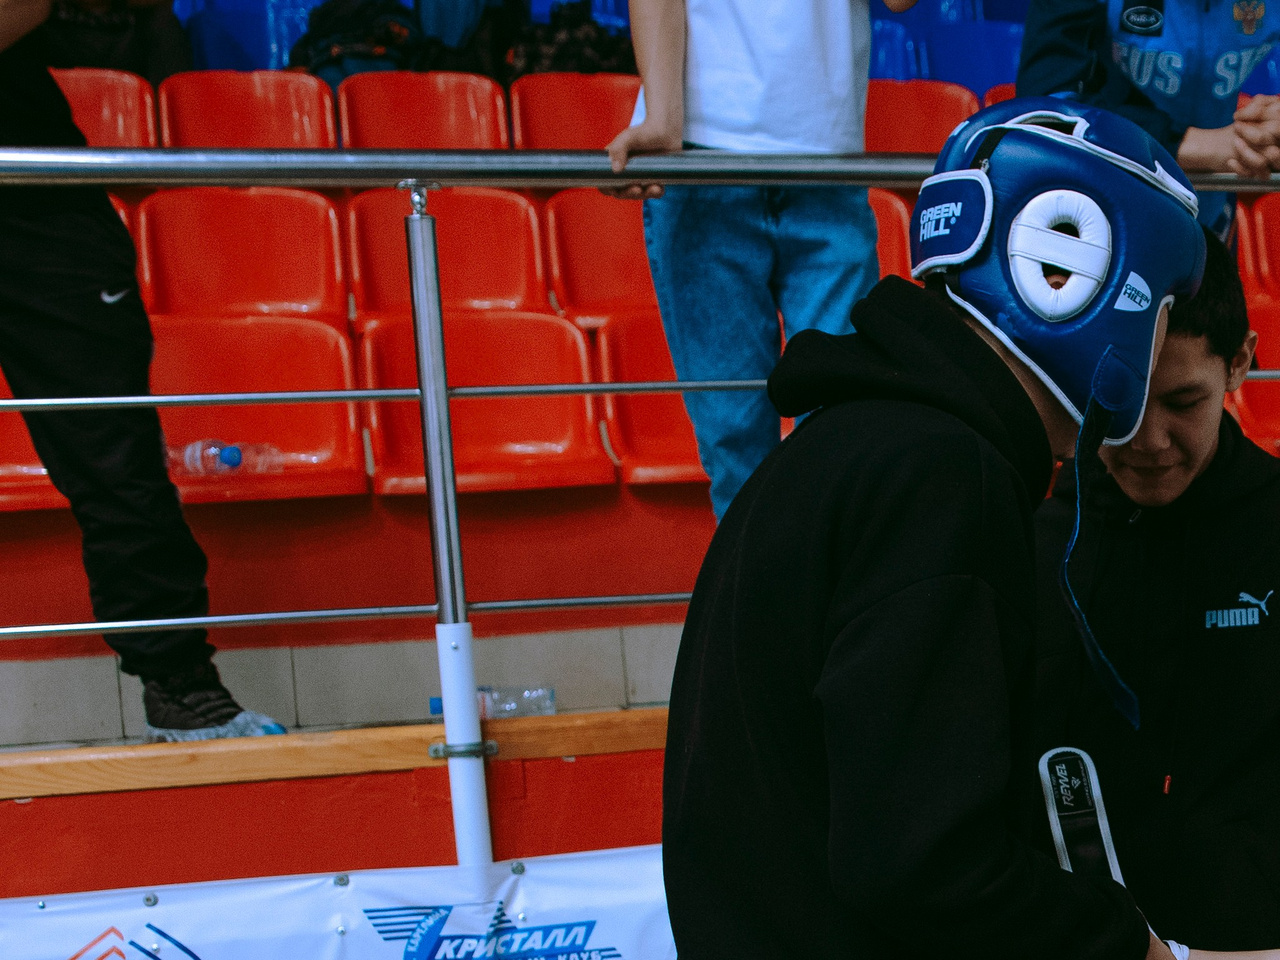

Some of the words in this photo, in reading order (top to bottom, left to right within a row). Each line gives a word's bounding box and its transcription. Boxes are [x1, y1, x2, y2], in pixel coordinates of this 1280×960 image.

[920, 202, 962, 225] GREEN
[920, 217, 950, 242] HILL
[1123, 289, 1143, 308] HILL
[1125, 284, 1150, 304] GREEN
[1205, 607, 1259, 628] PUMA
[434, 926, 587, 960] КРИСТАЛЛ
